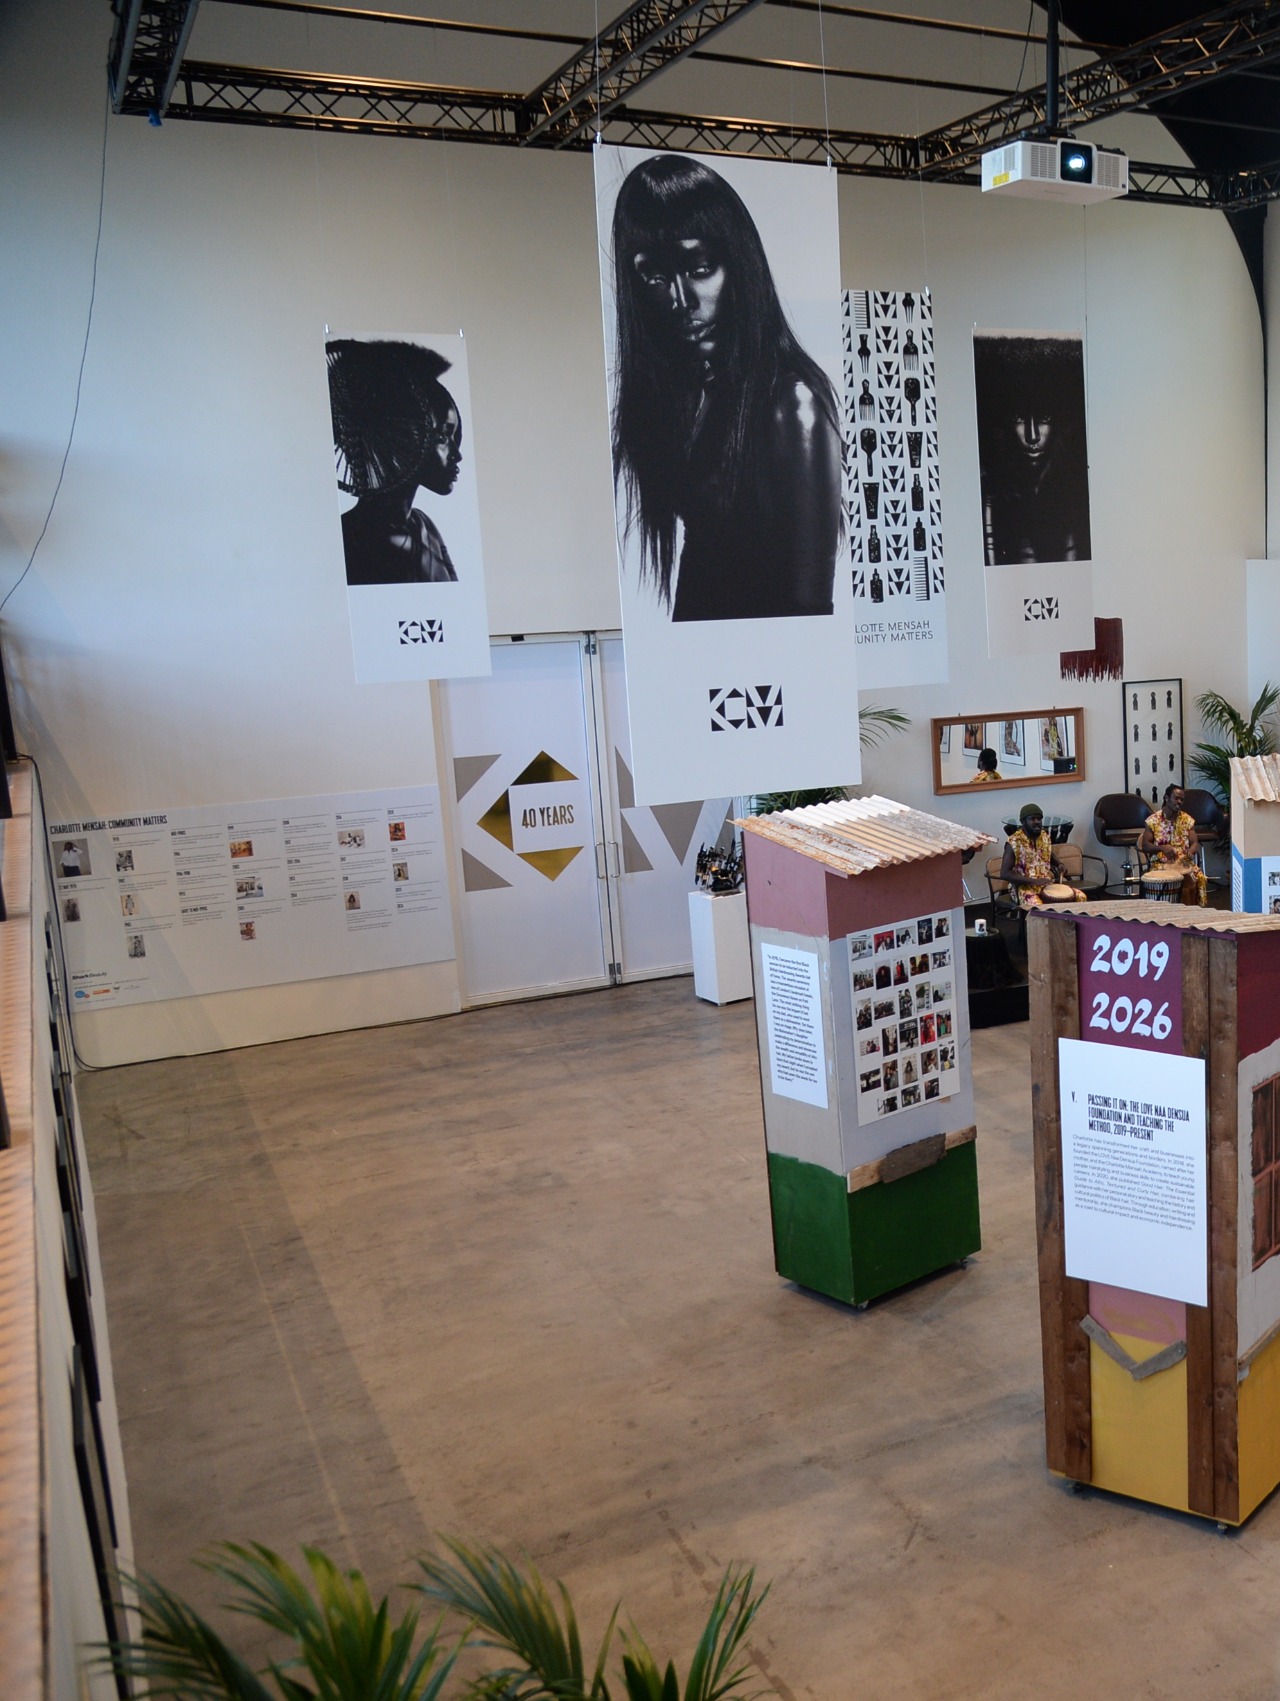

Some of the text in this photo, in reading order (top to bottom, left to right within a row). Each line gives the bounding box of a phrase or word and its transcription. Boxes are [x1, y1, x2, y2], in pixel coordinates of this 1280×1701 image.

[855, 620, 930, 633] LOTTE MENSAH
[856, 631, 933, 644] UNITY MATTERS
[49, 815, 168, 835] CHARLOTTE MENSAH: COMMUNITY MATTERS
[522, 804, 575, 829] 40 YEARS
[1090, 934, 1170, 981] 2019
[1089, 992, 1172, 1040] 2026
[1088, 1093, 1111, 1108] PASSING
[1113, 1097, 1118, 1109] IT
[1130, 1100, 1139, 1113] THE
[1141, 1102, 1154, 1116] LOVE
[1155, 1105, 1166, 1118] NAA
[1168, 1107, 1190, 1122] DENSUA
[1088, 1106, 1174, 1132] FOUNDATION AND TEACHING THE
[1088, 1119, 1113, 1135] METHOD,
